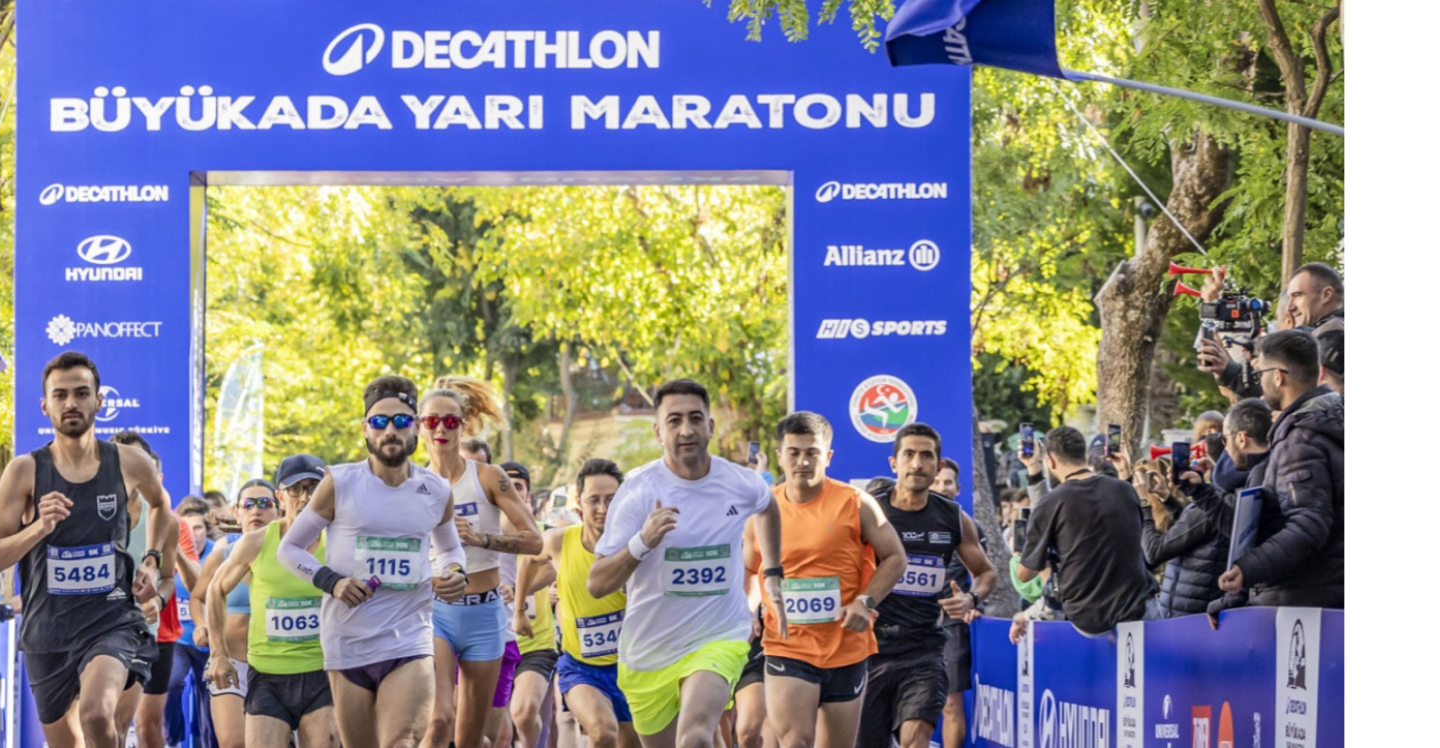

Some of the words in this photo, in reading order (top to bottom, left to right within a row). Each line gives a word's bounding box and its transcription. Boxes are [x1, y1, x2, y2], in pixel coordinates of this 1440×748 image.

[391, 30, 660, 69] DECATHLON
[49, 85, 393, 132] BÜYÜKADA
[400, 94, 544, 130] YARI
[570, 93, 935, 130] MARATONU
[65, 185, 169, 202] DECATHLON
[842, 182, 947, 199] DECATHLON
[823, 245, 905, 266] Allianz
[65, 267, 143, 282] HYUNDAI
[76, 321, 163, 338] PANOFFECT
[871, 320, 947, 336] SPORTS
[54, 563, 110, 582] 5484
[366, 557, 411, 577] 1115
[672, 566, 726, 585] 2392
[785, 596, 836, 614] 2069
[271, 613, 320, 631] 1063
[583, 627, 622, 648] 534
